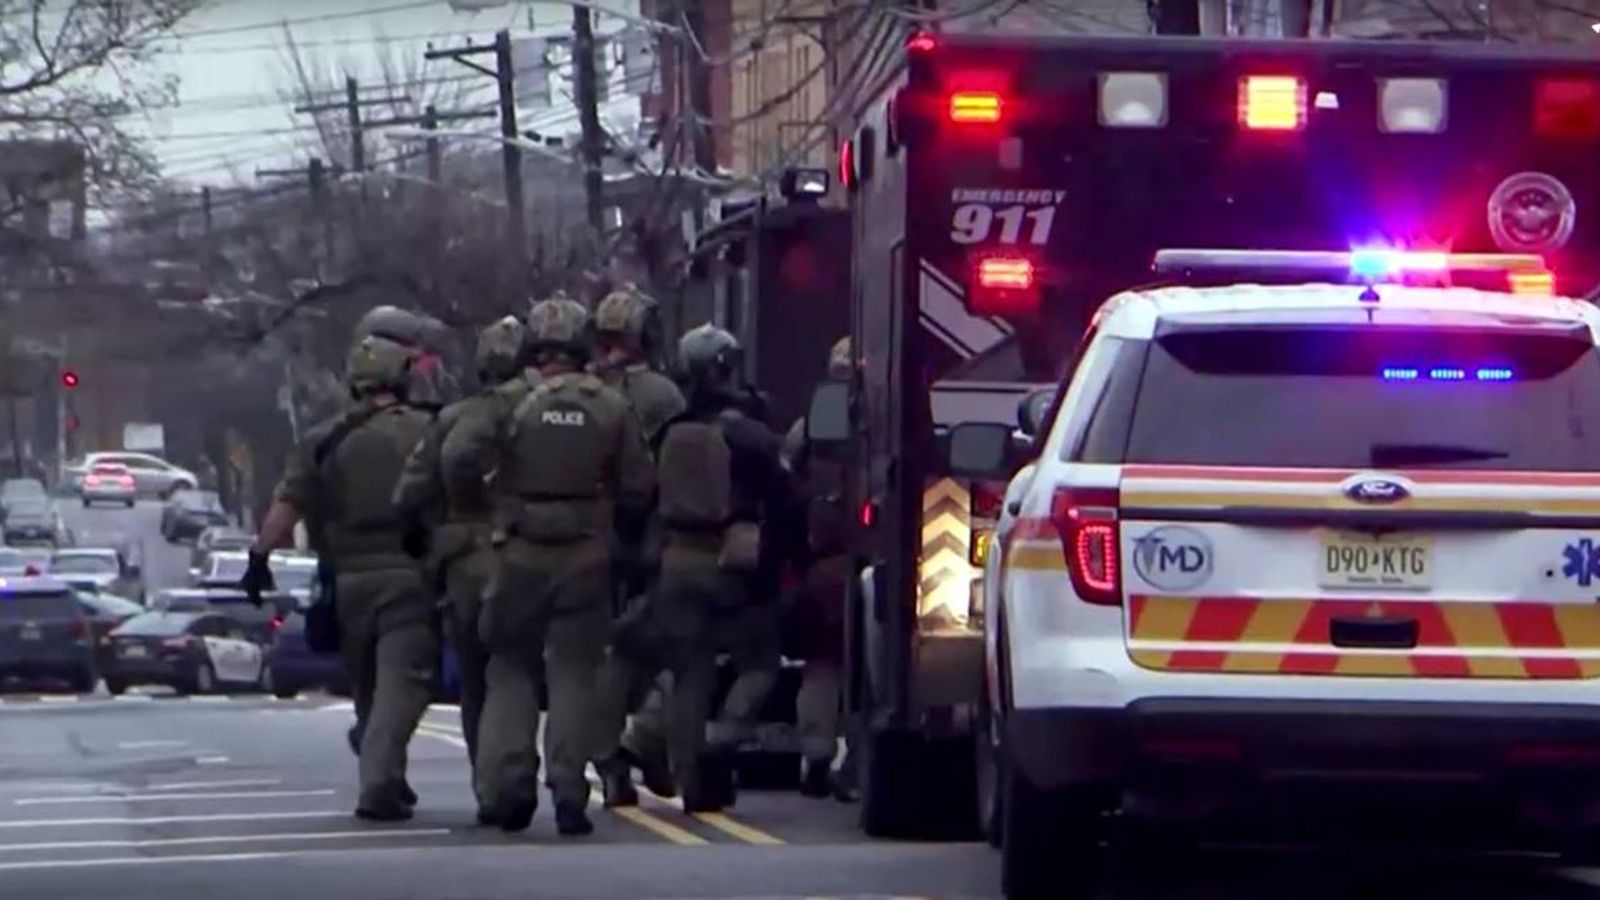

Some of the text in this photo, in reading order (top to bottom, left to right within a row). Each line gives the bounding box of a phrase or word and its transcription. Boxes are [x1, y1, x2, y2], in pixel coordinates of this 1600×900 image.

[951, 188, 1067, 203] EMERGENCY
[950, 204, 1055, 244] 911
[541, 410, 585, 427] POLICE
[1160, 545, 1204, 573] MD
